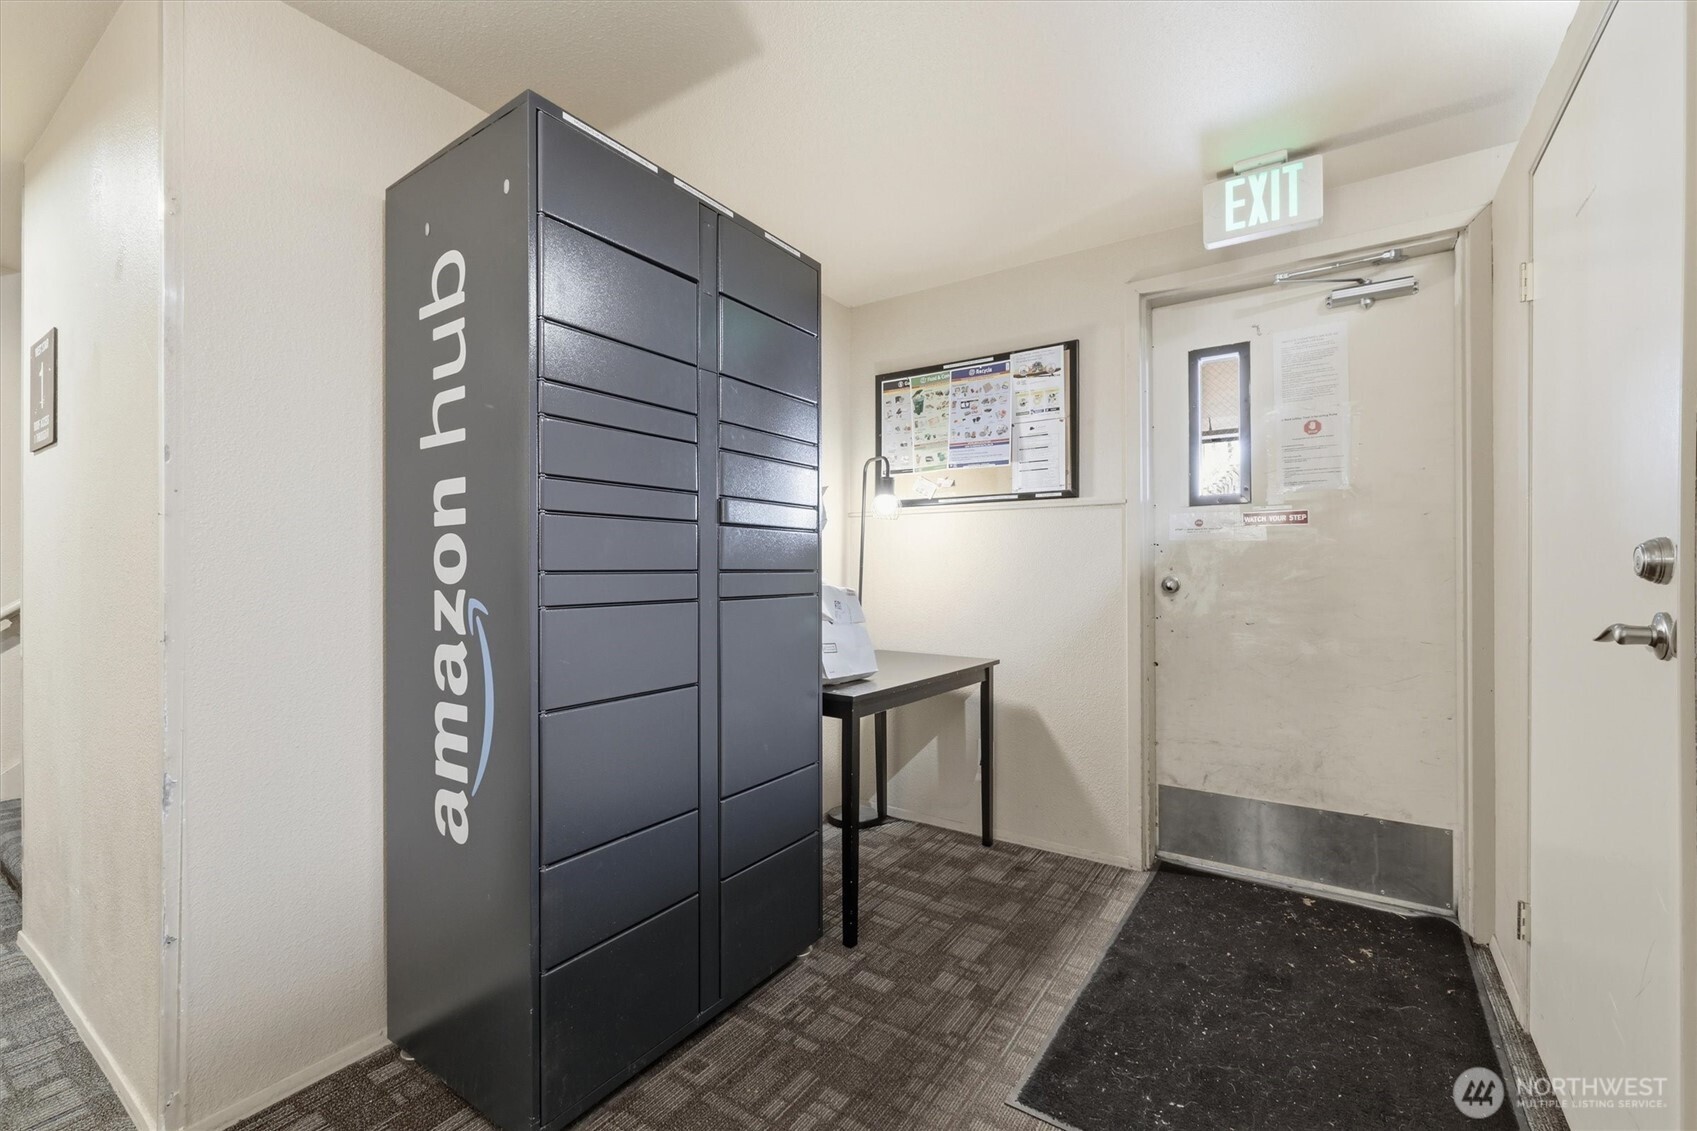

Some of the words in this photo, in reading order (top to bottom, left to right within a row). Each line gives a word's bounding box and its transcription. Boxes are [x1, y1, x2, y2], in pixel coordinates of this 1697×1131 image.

[1225, 161, 1304, 232] EXIT
[419, 250, 467, 450] hub
[1288, 513, 1307, 521] STEP
[433, 476, 469, 845] amazon
